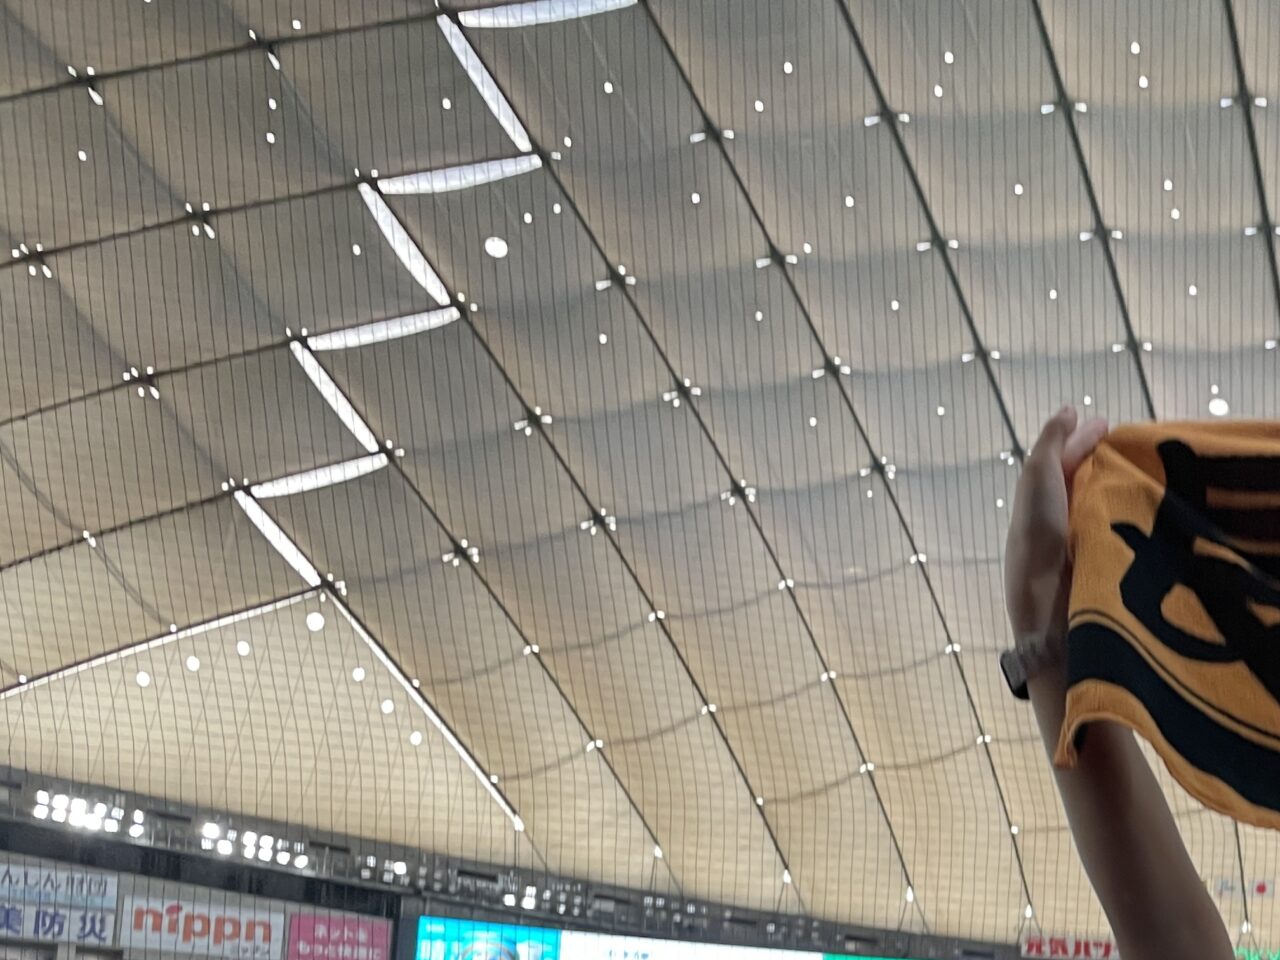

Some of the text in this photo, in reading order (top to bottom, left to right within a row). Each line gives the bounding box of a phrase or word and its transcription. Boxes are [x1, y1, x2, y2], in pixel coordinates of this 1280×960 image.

[0, 868, 108, 897] んしん財団
[133, 904, 272, 947] nippn
[1026, 937, 1113, 958] 元気ハツ
